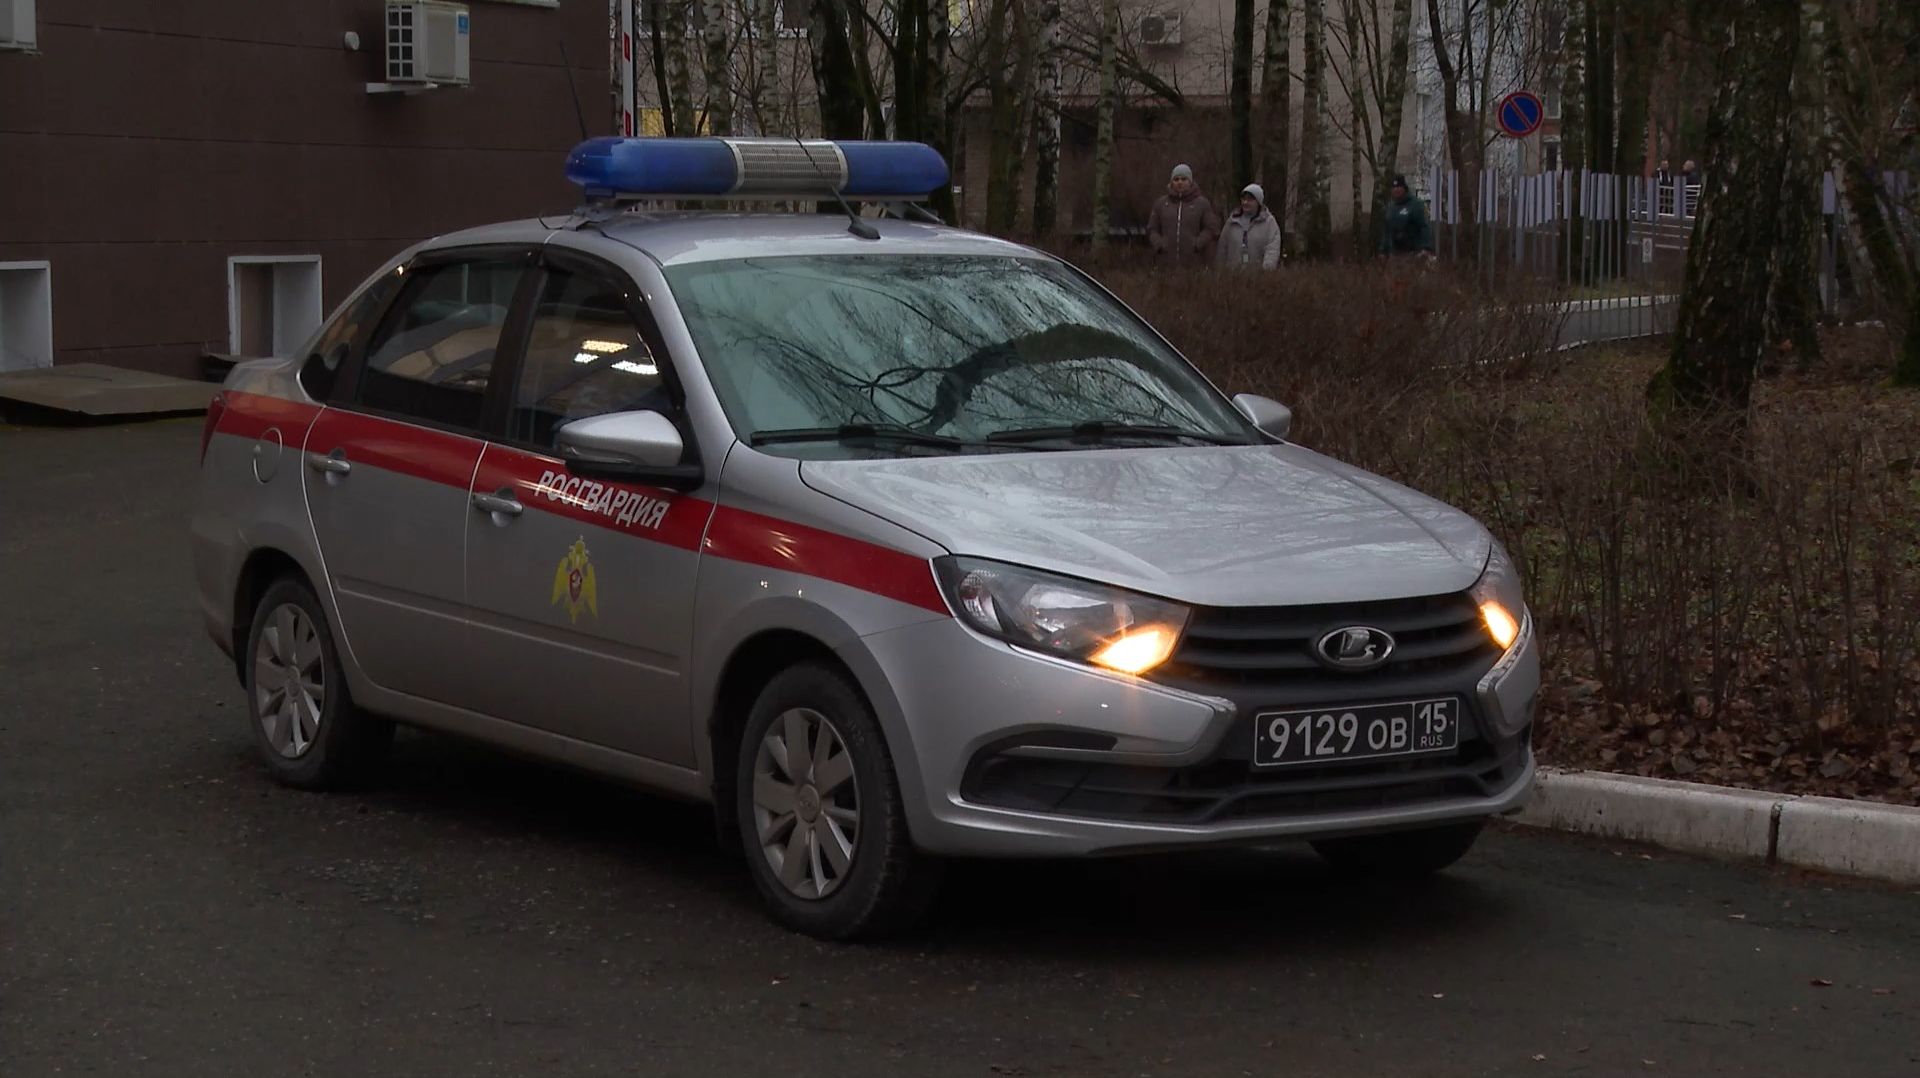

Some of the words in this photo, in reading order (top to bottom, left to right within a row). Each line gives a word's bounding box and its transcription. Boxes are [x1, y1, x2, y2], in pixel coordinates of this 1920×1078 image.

[535, 471, 671, 530] РОСГВАРДИЯ
[1268, 713, 1358, 758] 9129
[1419, 702, 1447, 734] 15
[1420, 734, 1443, 747] RUS
